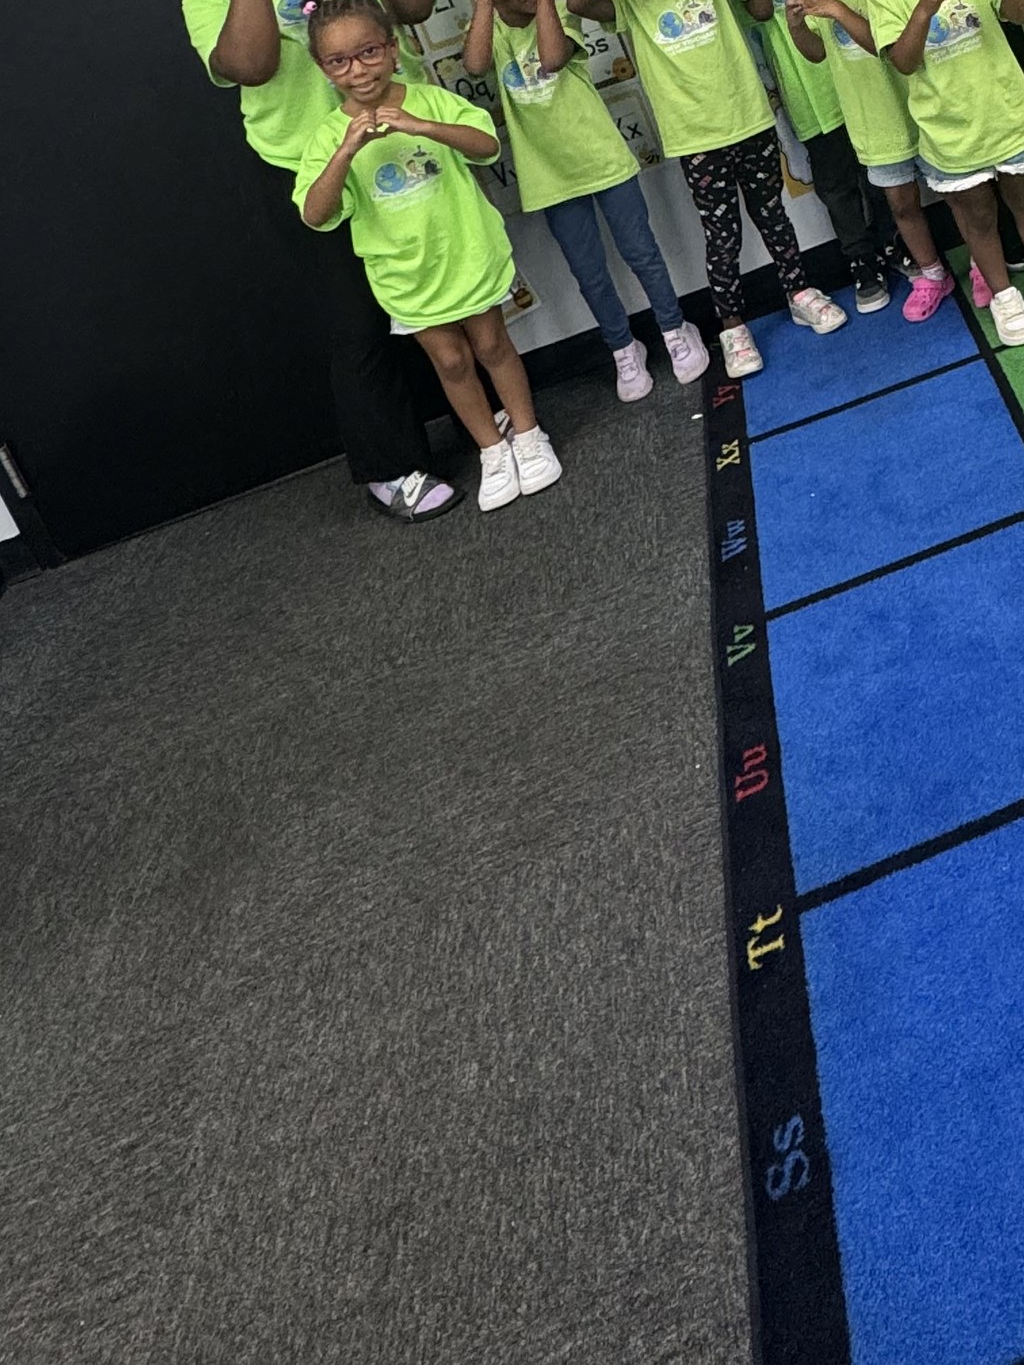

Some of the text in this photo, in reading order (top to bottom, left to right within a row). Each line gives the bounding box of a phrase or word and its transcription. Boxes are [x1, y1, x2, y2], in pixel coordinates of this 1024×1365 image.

[456, 78, 495, 103] Qq
[716, 439, 740, 471] Xx
[721, 518, 747, 562] Ww
[727, 623, 756, 667] Vv
[735, 742, 769, 803] Uu
[747, 903, 785, 970] Tt
[766, 1113, 811, 1201] Ss
